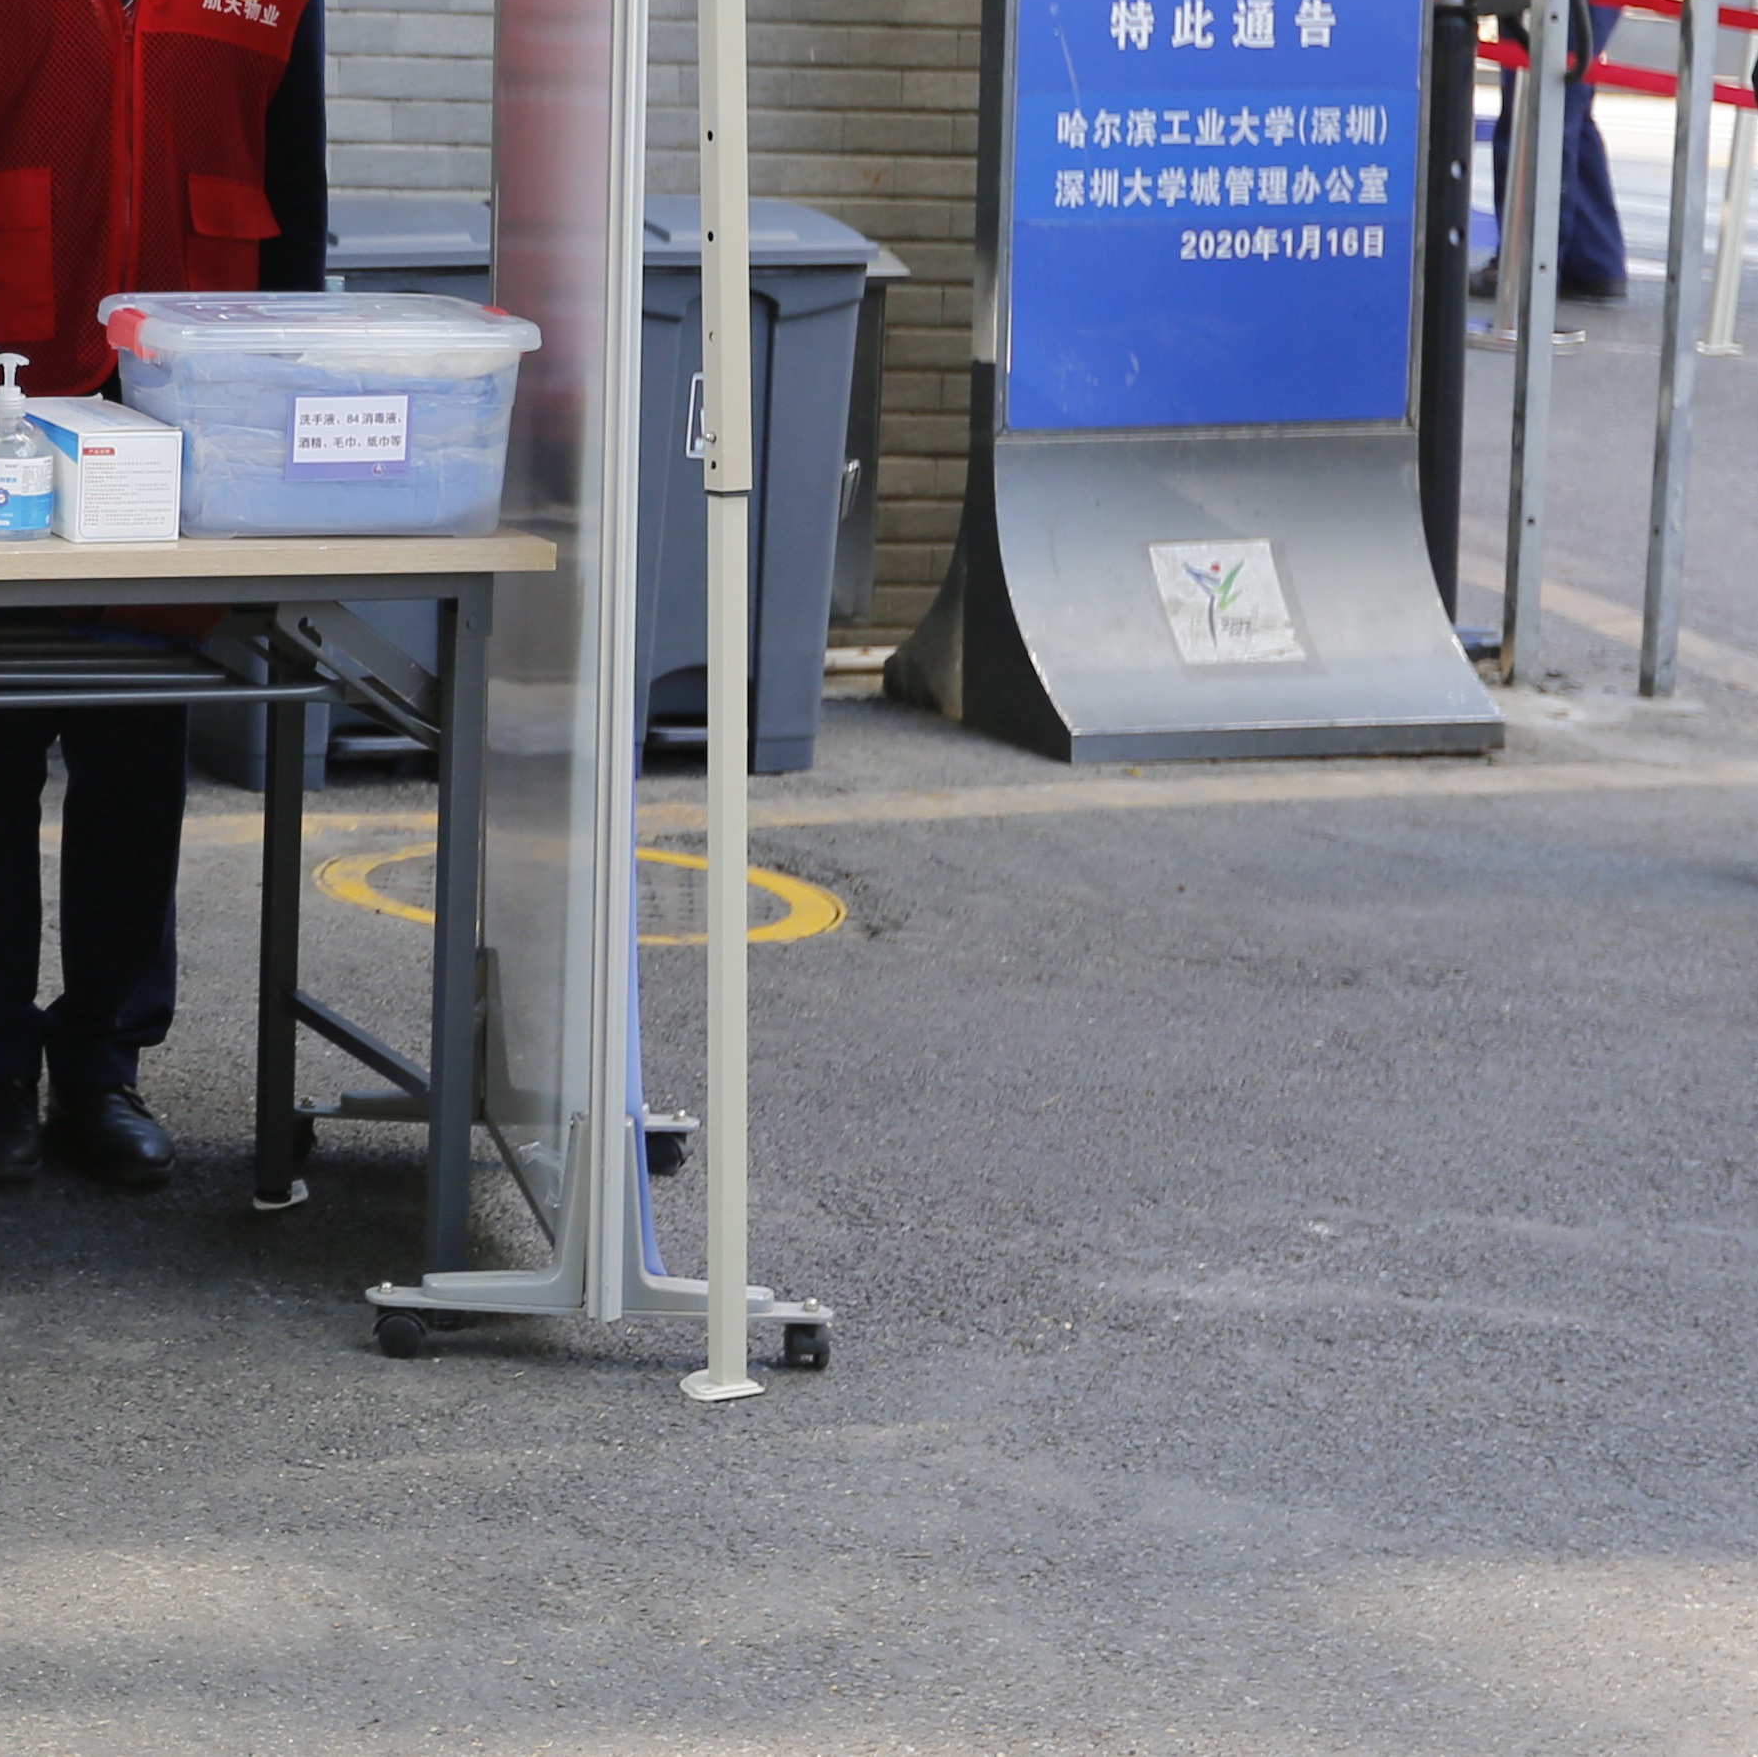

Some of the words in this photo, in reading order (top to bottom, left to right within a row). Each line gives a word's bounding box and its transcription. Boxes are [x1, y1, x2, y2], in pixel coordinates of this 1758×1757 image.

[1055, 167, 1388, 208] 深圳大学城管理办公室
[1181, 226, 1383, 260] 2020年1月16日
